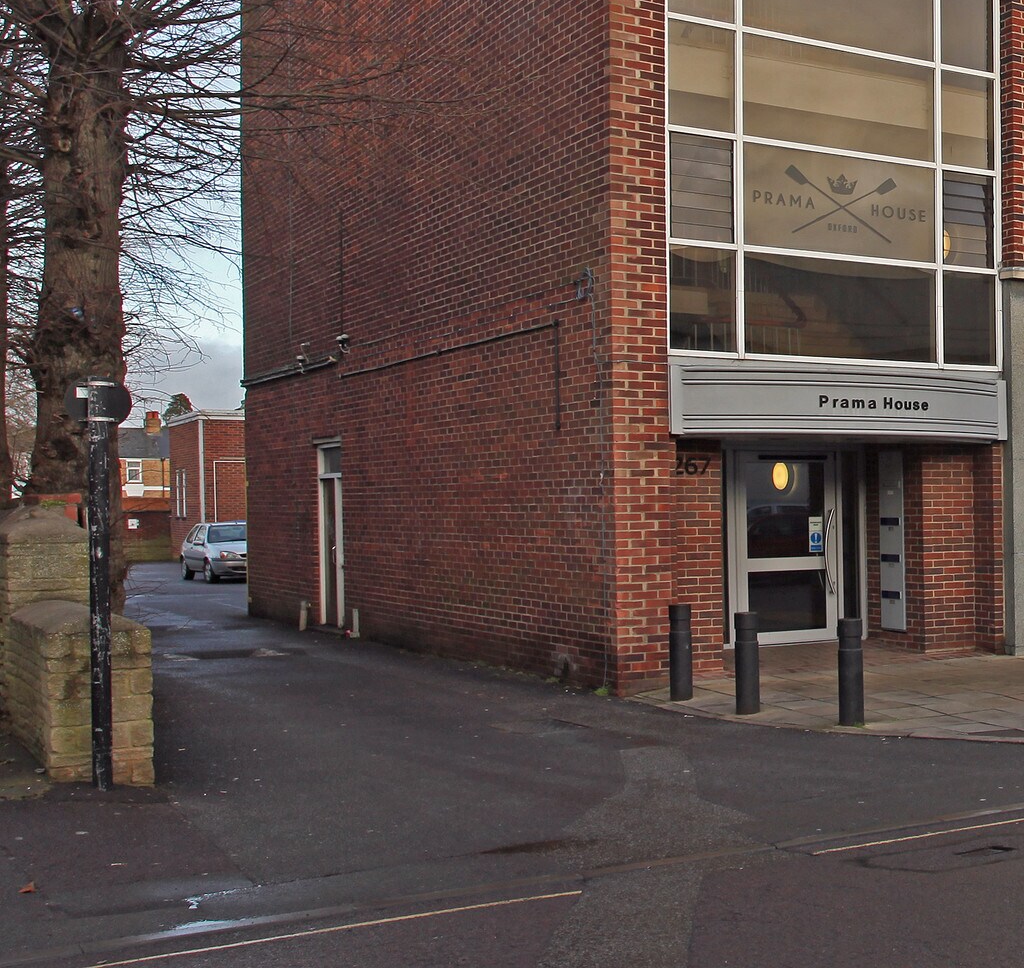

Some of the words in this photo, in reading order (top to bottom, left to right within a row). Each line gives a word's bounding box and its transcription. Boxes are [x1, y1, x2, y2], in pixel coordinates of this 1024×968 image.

[752, 189, 816, 210] PRAMA
[871, 204, 927, 223] HOUSE
[827, 222, 858, 234] OXFORD
[819, 395, 877, 410] Prama
[883, 396, 929, 411] House
